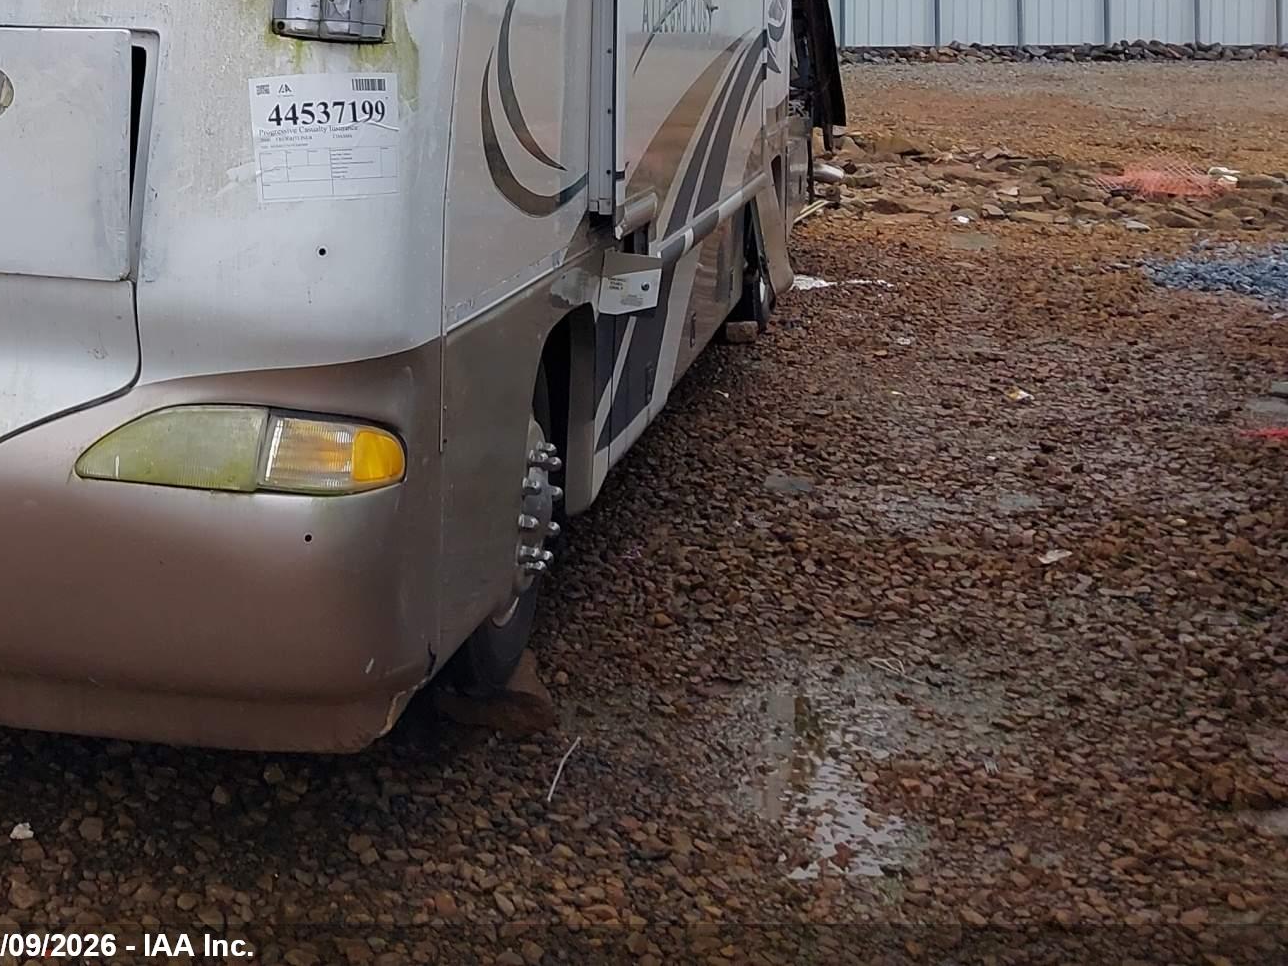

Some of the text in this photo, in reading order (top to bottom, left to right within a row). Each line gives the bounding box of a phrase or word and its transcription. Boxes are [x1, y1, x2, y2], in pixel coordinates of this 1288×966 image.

[267, 99, 386, 126] 44537199
[258, 128, 298, 137] Progressive
[298, 126, 328, 134] Casualty
